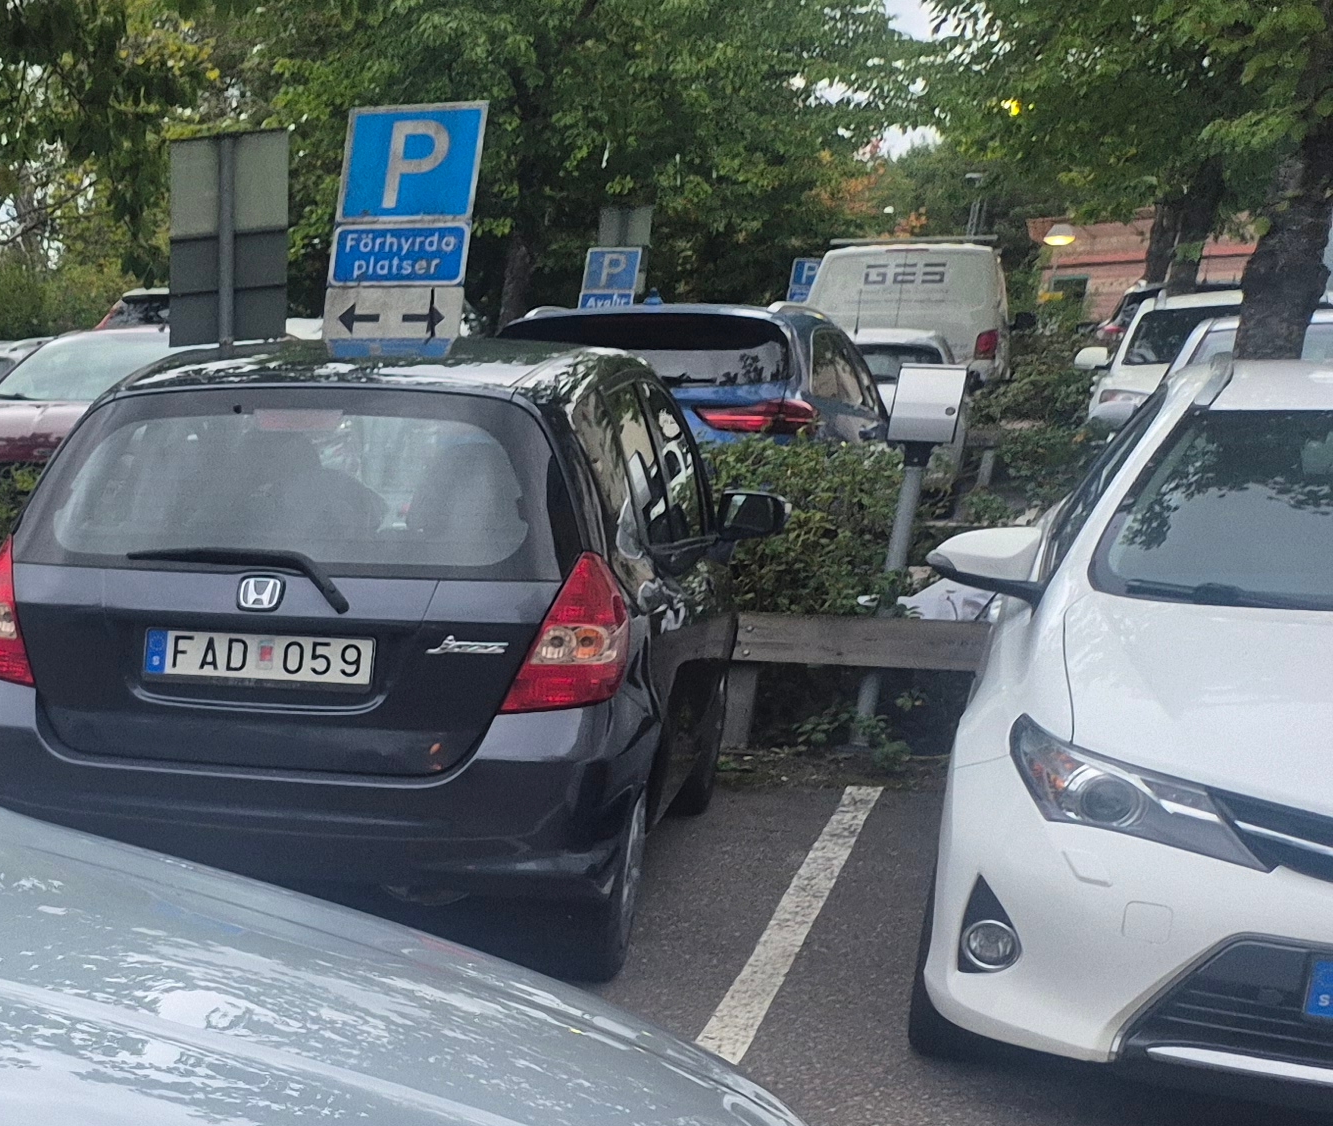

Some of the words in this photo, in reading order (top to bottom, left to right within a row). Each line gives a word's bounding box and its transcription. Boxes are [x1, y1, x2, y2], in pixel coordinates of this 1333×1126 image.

[381, 119, 450, 209] P
[352, 255, 441, 280] platser
[599, 253, 628, 287] P
[801, 262, 819, 285] P
[863, 261, 947, 285] GES
[171, 634, 250, 673] FAD
[282, 640, 363, 678] 059
